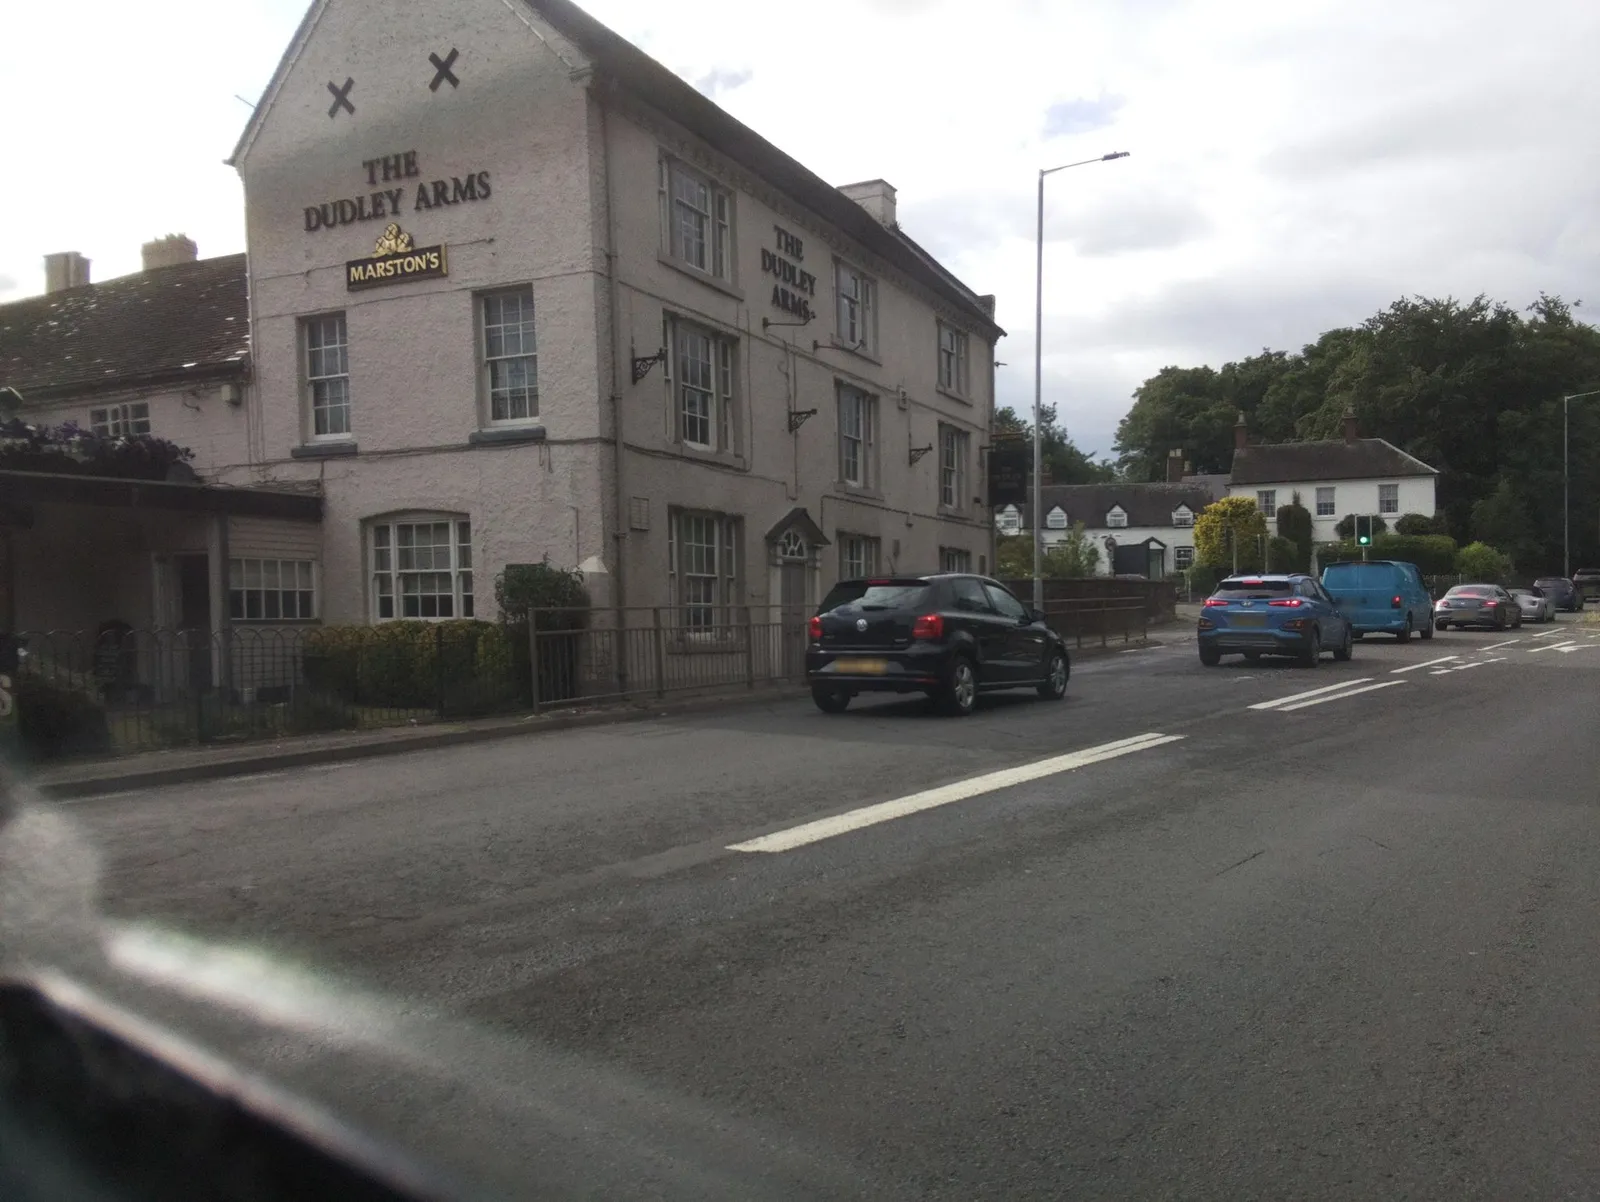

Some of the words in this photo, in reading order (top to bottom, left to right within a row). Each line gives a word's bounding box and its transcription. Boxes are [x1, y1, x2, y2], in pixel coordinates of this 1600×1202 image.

[362, 150, 420, 185] THE
[303, 188, 404, 231] DUDLEY
[414, 171, 492, 211] ARMS
[773, 224, 804, 262] THE
[350, 252, 440, 282] MARSTON'S
[761, 248, 817, 297] DUDLEY
[771, 284, 811, 321] ARMS
